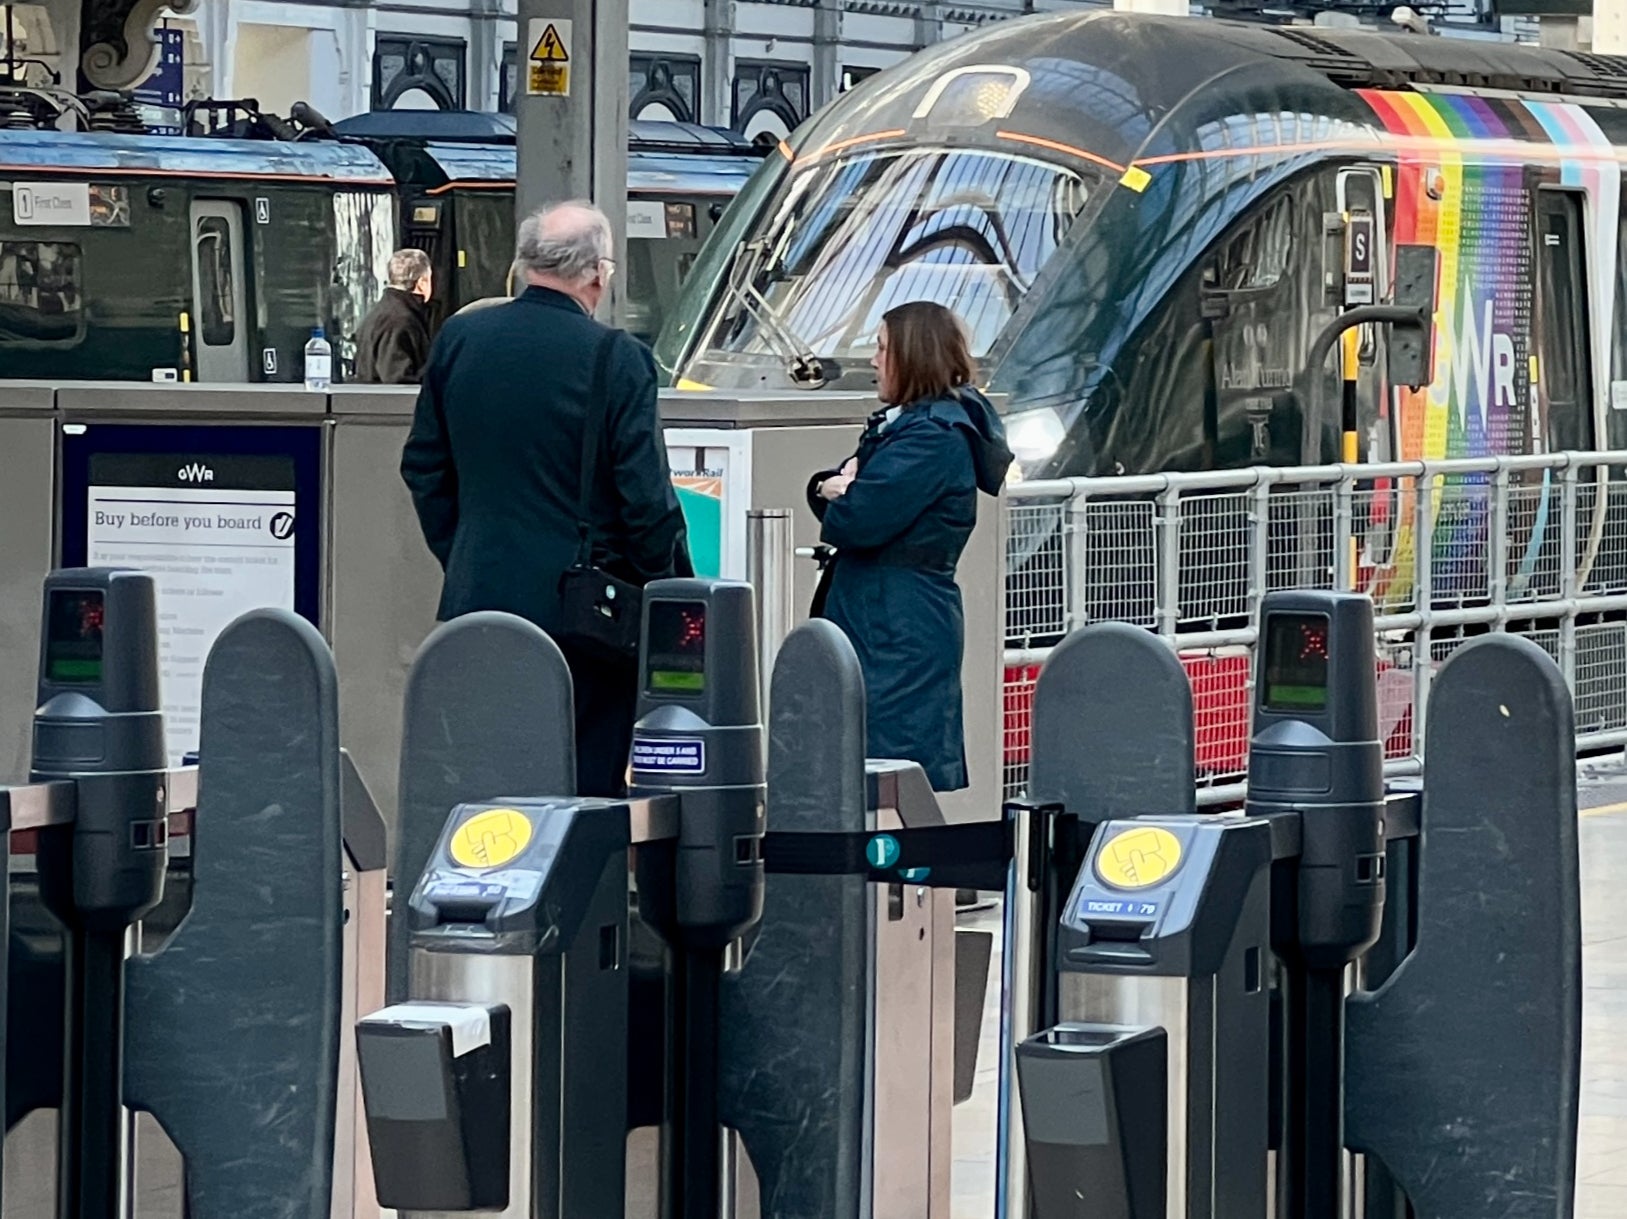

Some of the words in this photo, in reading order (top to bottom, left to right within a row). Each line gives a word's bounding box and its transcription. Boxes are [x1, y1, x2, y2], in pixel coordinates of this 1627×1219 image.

[1355, 232, 1366, 261] S
[178, 462, 214, 483] GWR
[94, 510, 125, 529] Buy
[130, 511, 179, 527] before
[183, 516, 212, 530] you
[217, 514, 262, 530] board
[1088, 901, 1123, 913] TICKET
